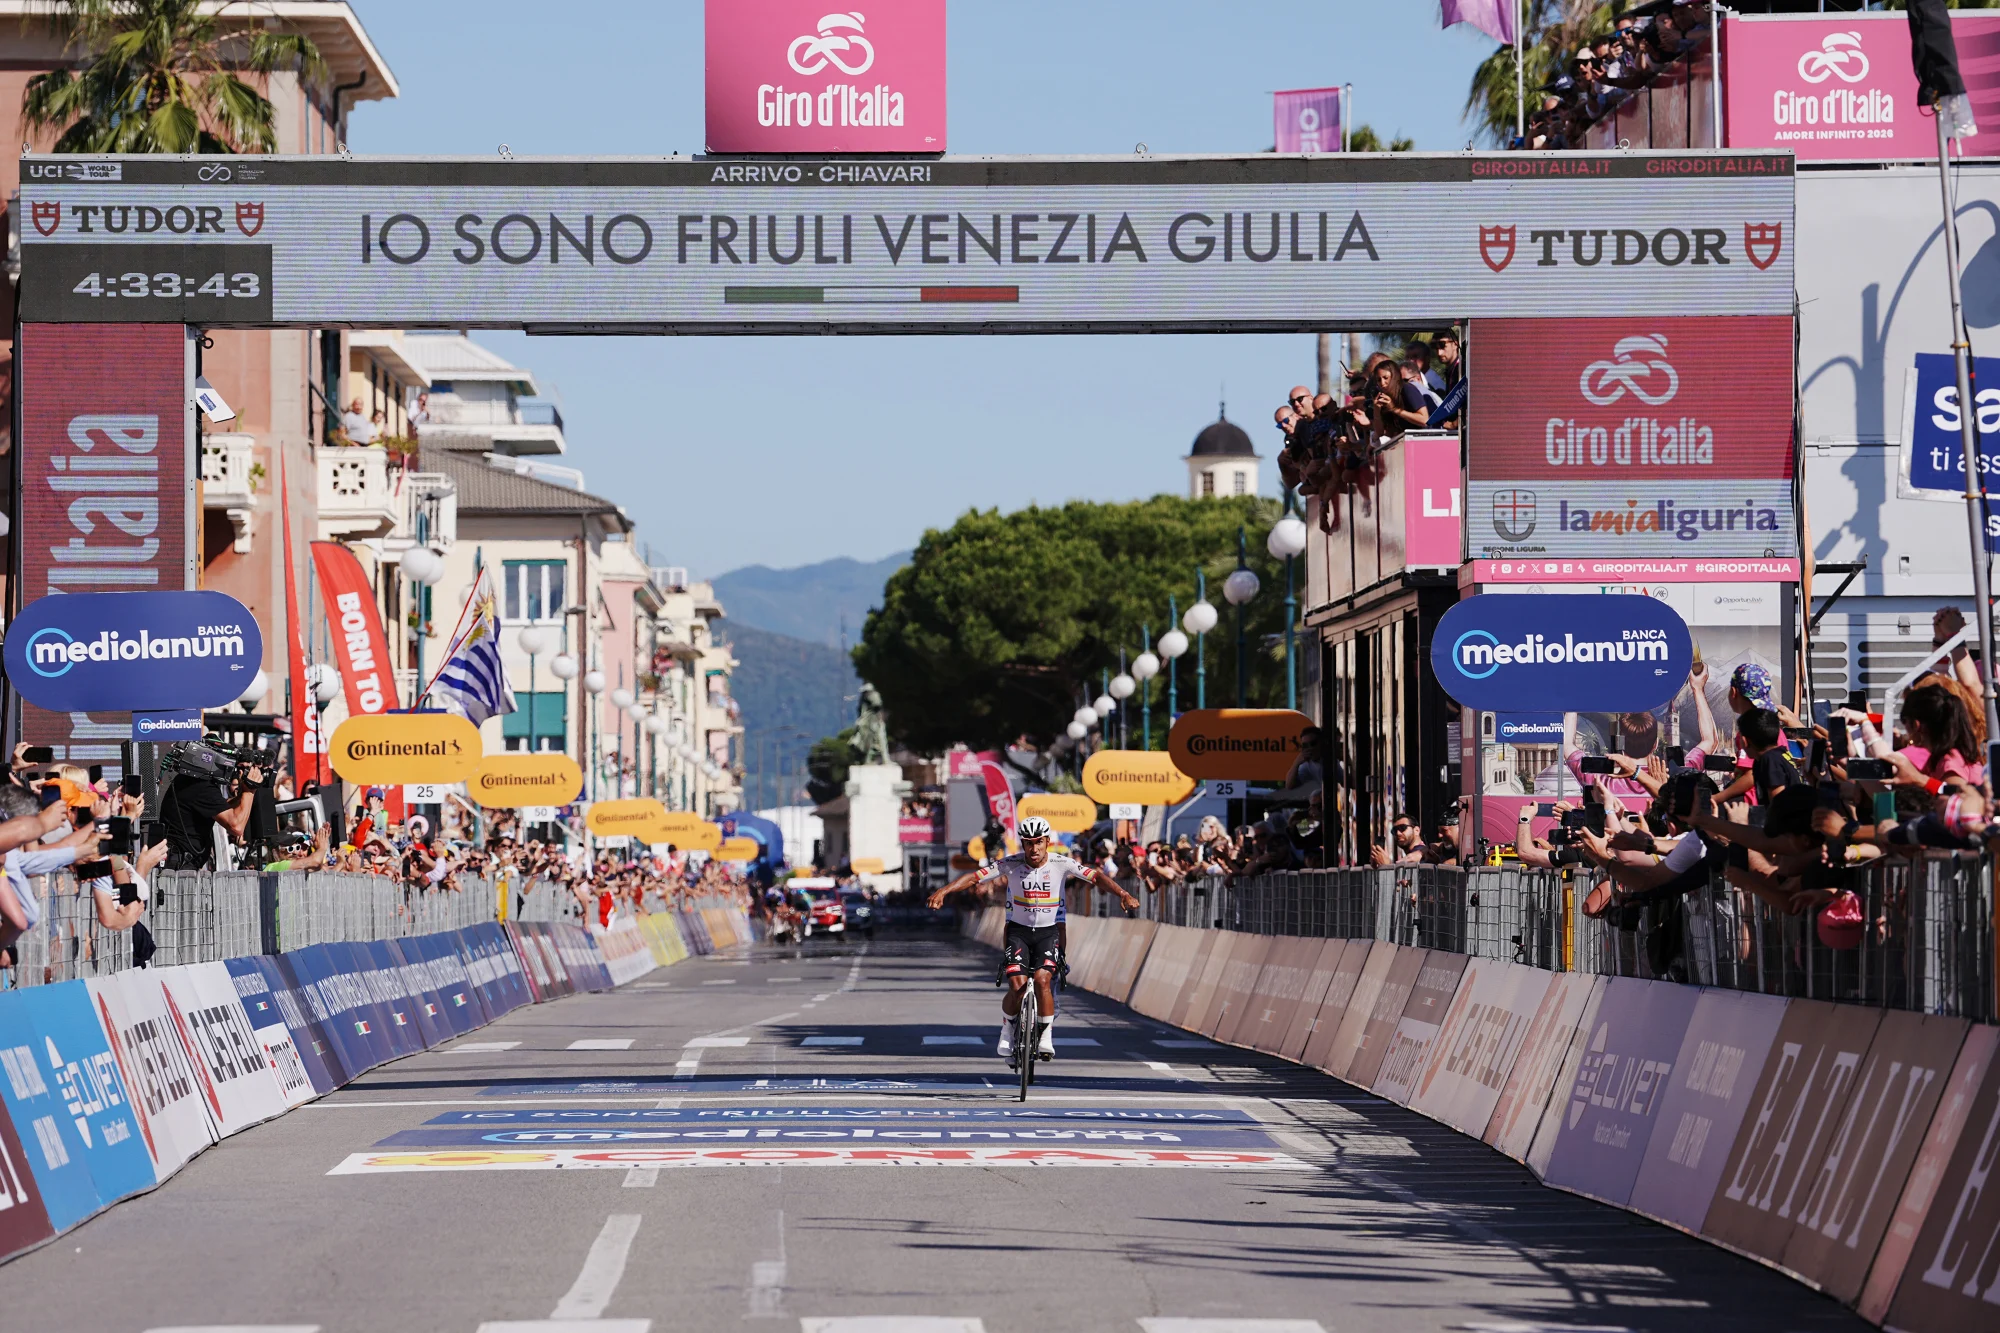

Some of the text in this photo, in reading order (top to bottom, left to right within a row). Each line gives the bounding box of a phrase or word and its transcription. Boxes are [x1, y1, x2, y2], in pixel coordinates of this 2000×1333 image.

[757, 83, 905, 127] Giro d'Italia
[1773, 88, 1894, 125] Giro d'Italia
[1774, 129, 1894, 140] AMORE INFINITO 2026
[29, 164, 63, 178] UCI
[711, 166, 802, 183] ARRIVO
[819, 165, 931, 182] CHIAVARI
[1471, 159, 1612, 175] GIRODITALIA.IT
[1645, 157, 1788, 174] GIRODITALIA.IT
[72, 204, 226, 233] TUDOR
[361, 210, 1381, 266] IO SONO FRIULI VENEZIA GIULIA
[1530, 228, 1730, 267] TUDOR
[73, 272, 260, 297] 4:33:43
[1546, 416, 1713, 466] Giro d'Italia
[1560, 499, 1779, 542] lamialiguria
[1592, 563, 1792, 574] GIRODITALIA.IT #GIRODITALIA
[197, 624, 242, 636] BANCA
[1622, 629, 1667, 640] BANCA
[35, 630, 244, 664] mediolanum
[336, 591, 384, 714] BORN TO
[1462, 633, 1669, 664] mediolanum
[140, 719, 202, 731] mediolanum
[1503, 724, 1564, 735] mediolanum
[347, 740, 447, 761] Continental
[1186, 733, 1286, 755] Continental
[480, 773, 555, 789] Continental
[1095, 769, 1170, 786] Continental
[416, 785, 434, 798] 25
[1216, 782, 1234, 795] 25
[534, 807, 548, 817] 50
[1118, 807, 1131, 817] 50
[1022, 881, 1051, 892] UAE
[188, 1000, 267, 1083] CASTELLI
[1446, 1002, 1531, 1092] CASTELLI
[124, 1014, 193, 1117] CASTELLI
[530, 1110, 681, 1118] SONO
[697, 1109, 831, 1117] FRIULI
[845, 1109, 1050, 1117] VENEZIA
[1064, 1110, 1225, 1120] GIULIA
[514, 1128, 1183, 1143] mediolanum
[1724, 1041, 1936, 1249] EATALY
[573, 1149, 1275, 1164] CONAD
